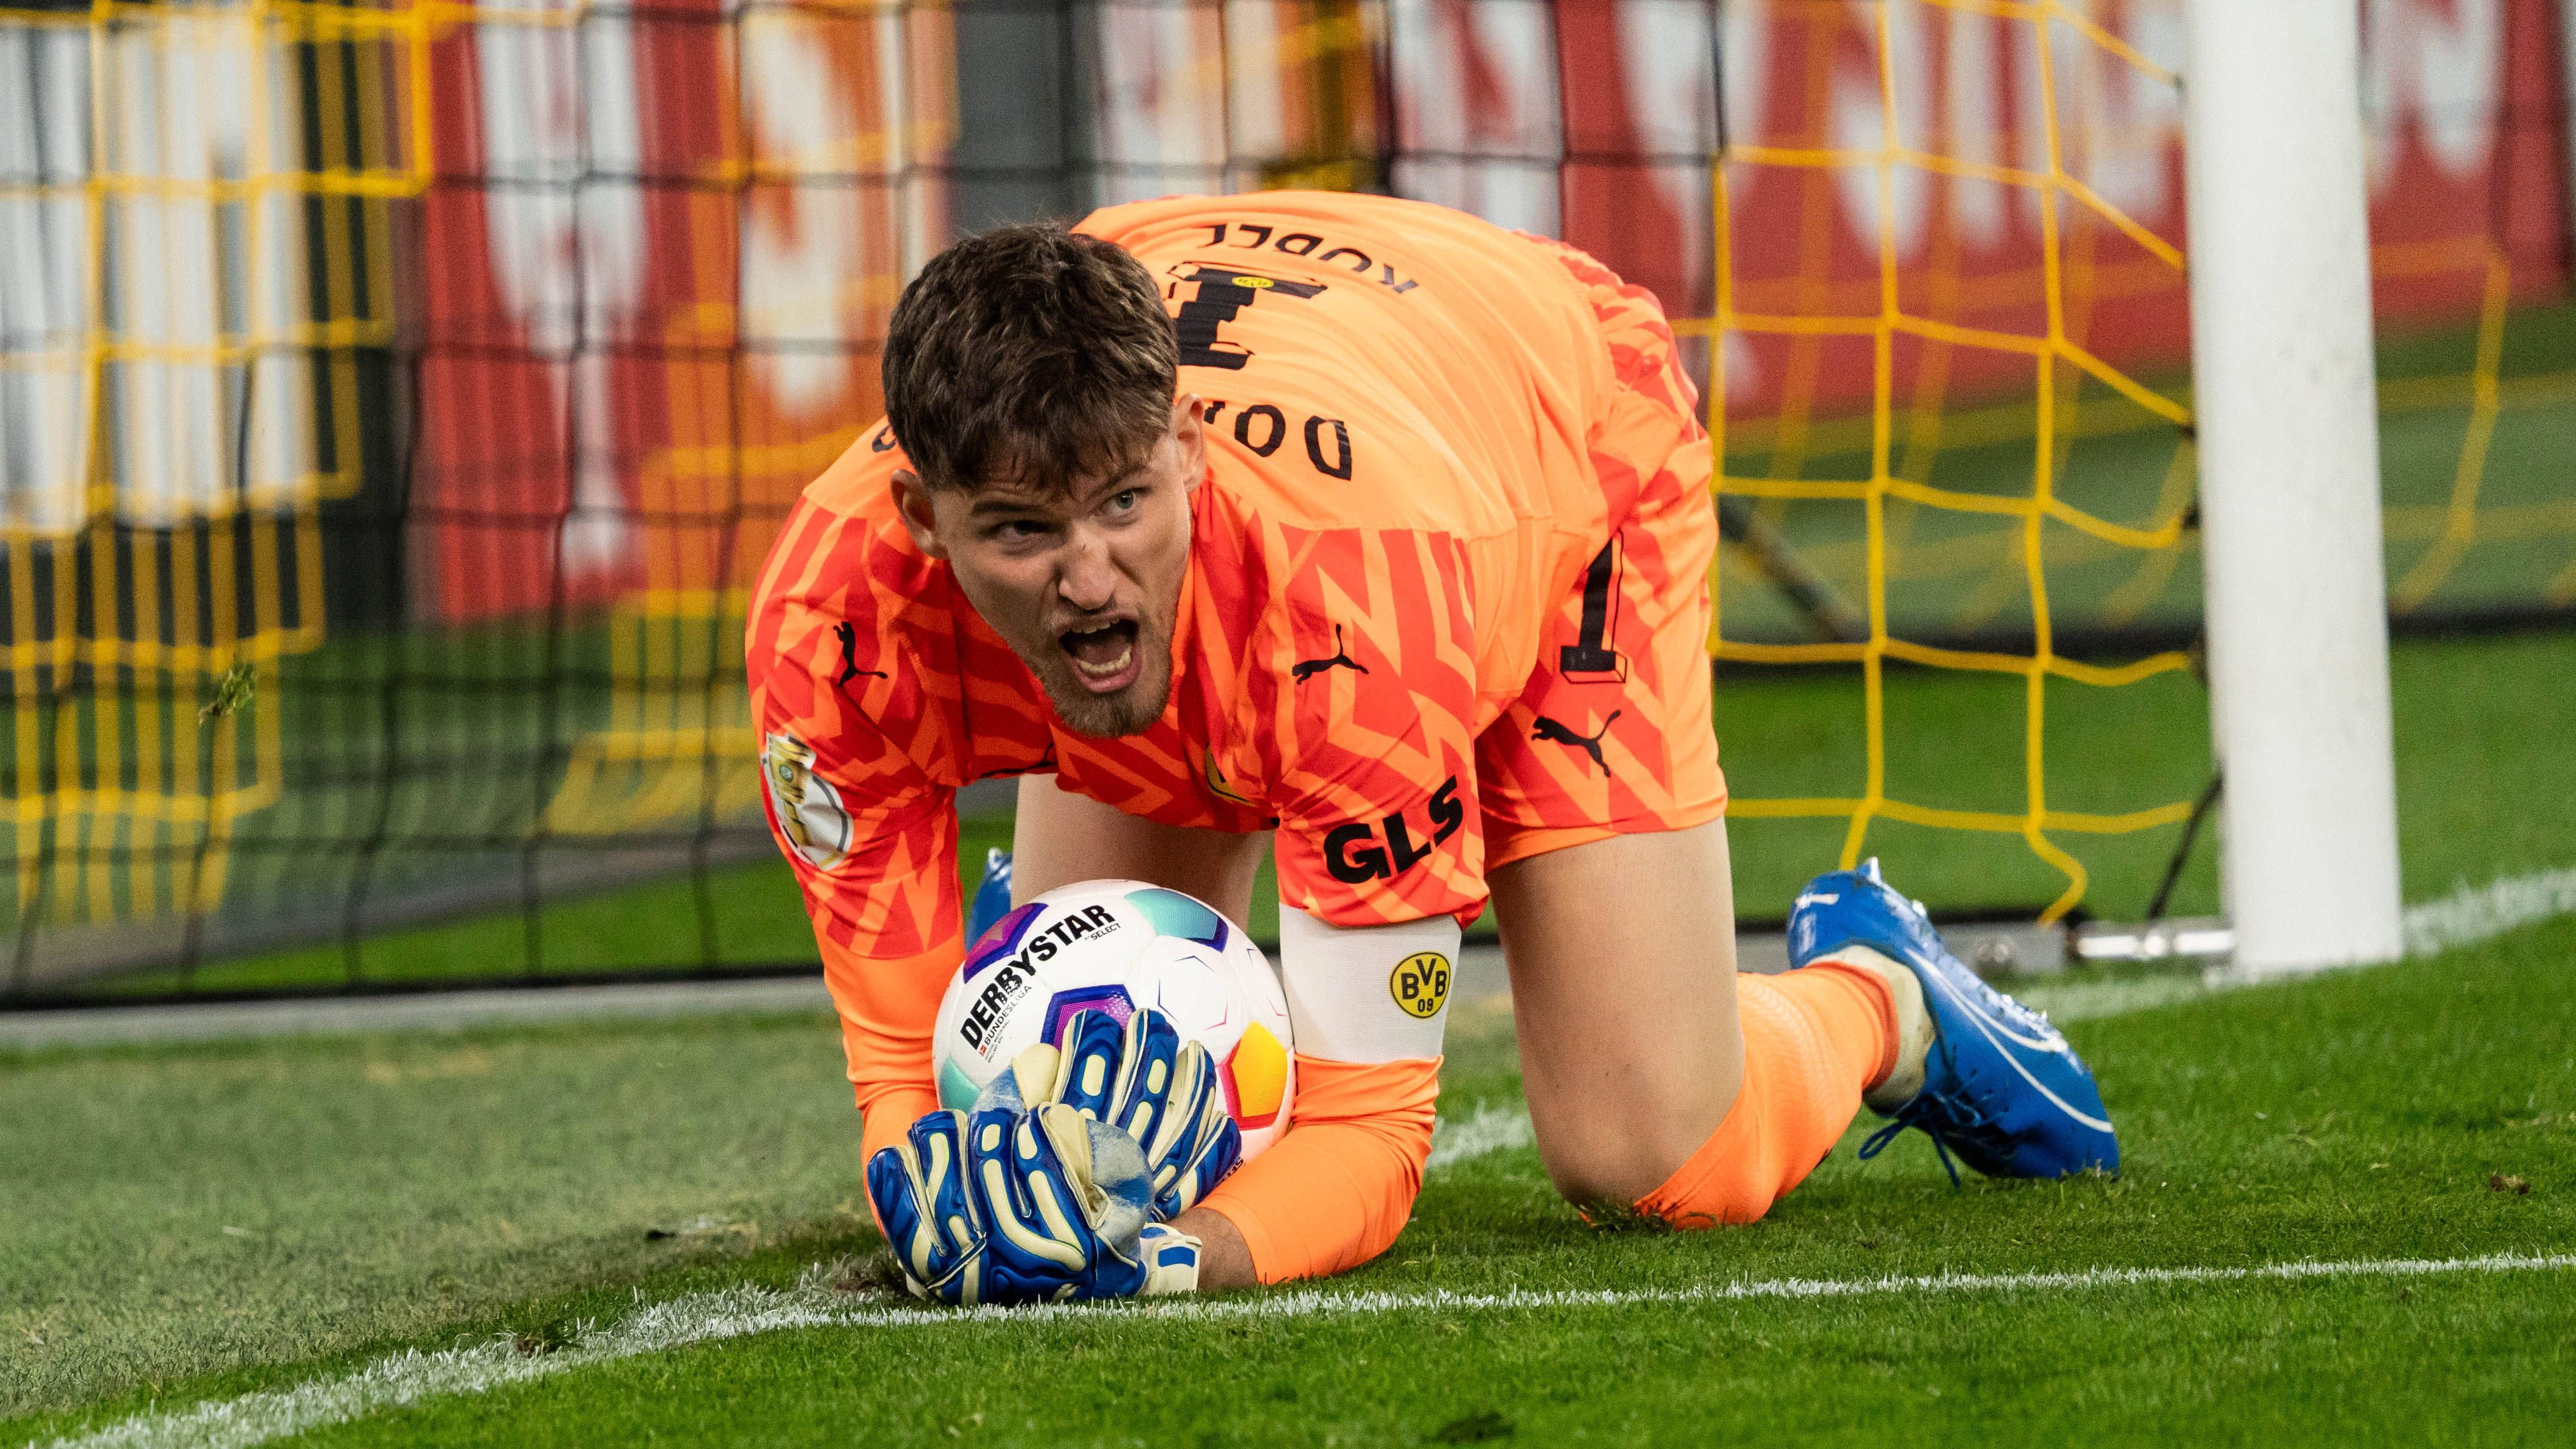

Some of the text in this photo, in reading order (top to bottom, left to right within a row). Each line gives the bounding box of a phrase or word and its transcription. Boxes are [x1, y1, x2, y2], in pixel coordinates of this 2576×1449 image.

[1560, 526, 1627, 684] 1
[1323, 775, 1463, 884] GLS
[1091, 923, 1121, 940] SELECT
[960, 905, 1115, 1050] DERBYSTAR
[1401, 958, 1447, 1000] BVB
[1417, 998, 1434, 1013] 09
[984, 985, 1032, 1045] BUNDESLIGA
